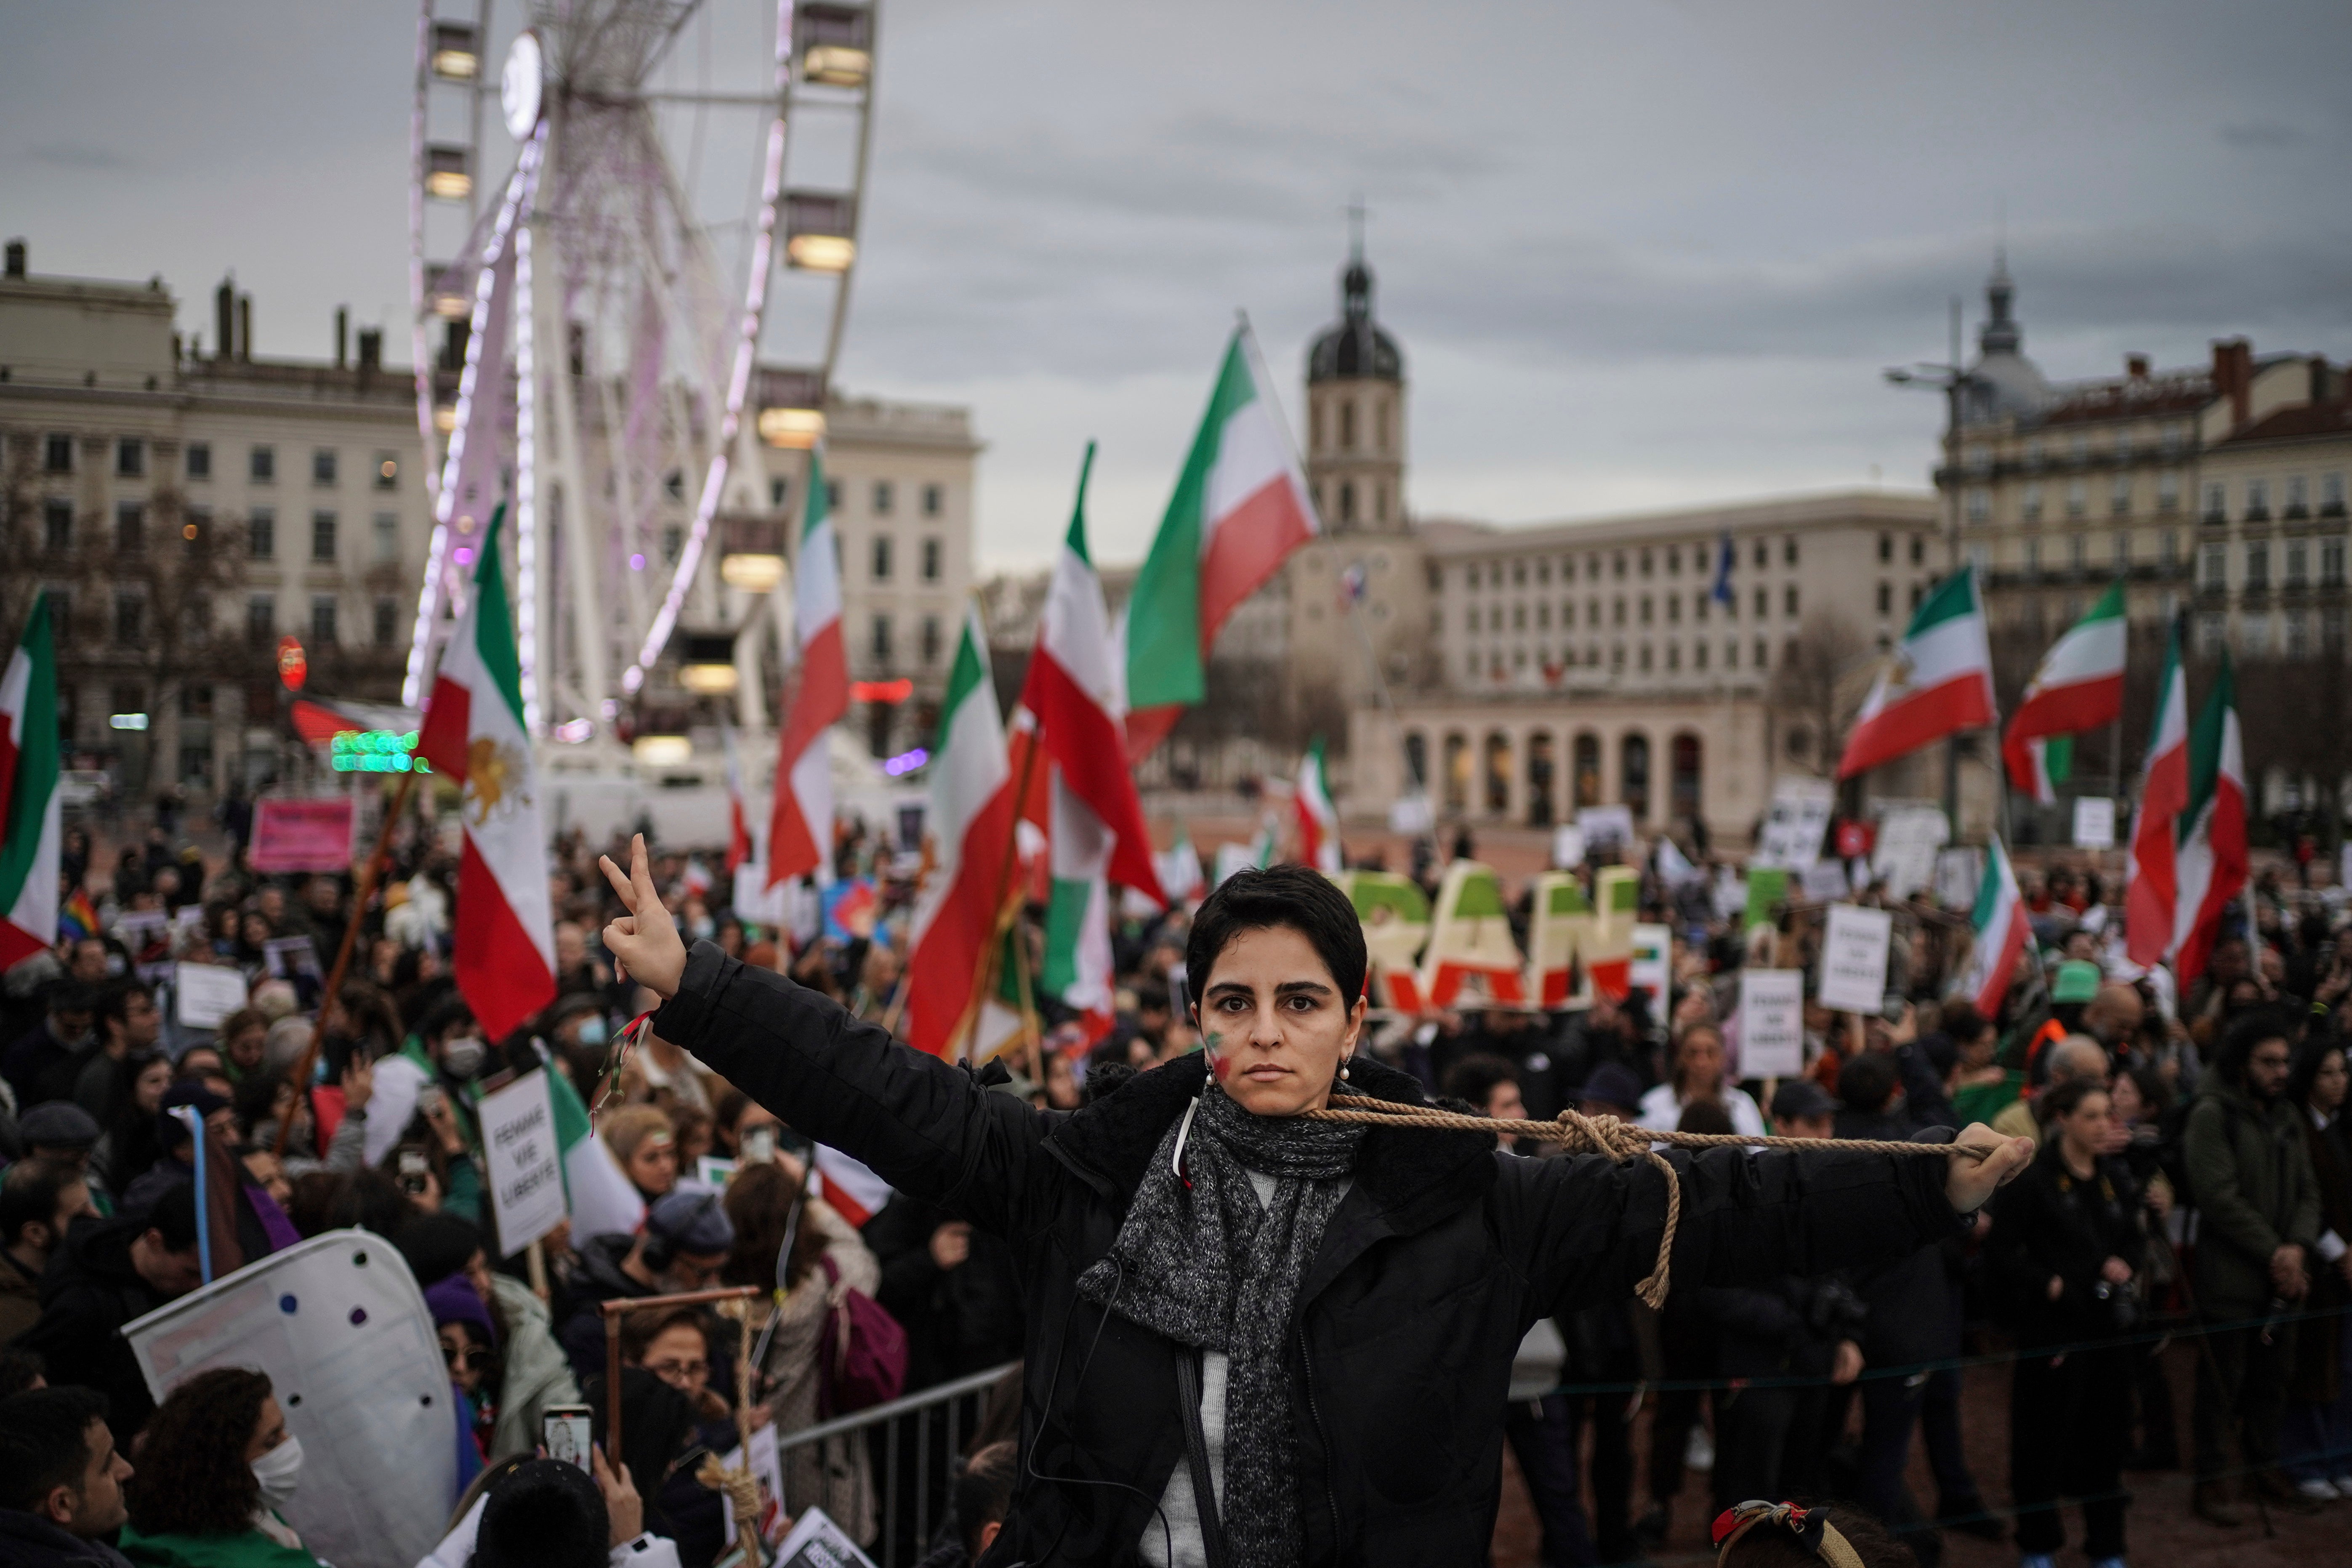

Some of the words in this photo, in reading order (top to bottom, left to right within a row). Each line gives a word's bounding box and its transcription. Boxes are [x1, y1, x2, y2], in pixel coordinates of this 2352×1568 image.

[1327, 858, 1640, 1013] RAN
[494, 1103, 546, 1151] FEMME
[511, 1139, 539, 1169] VIE
